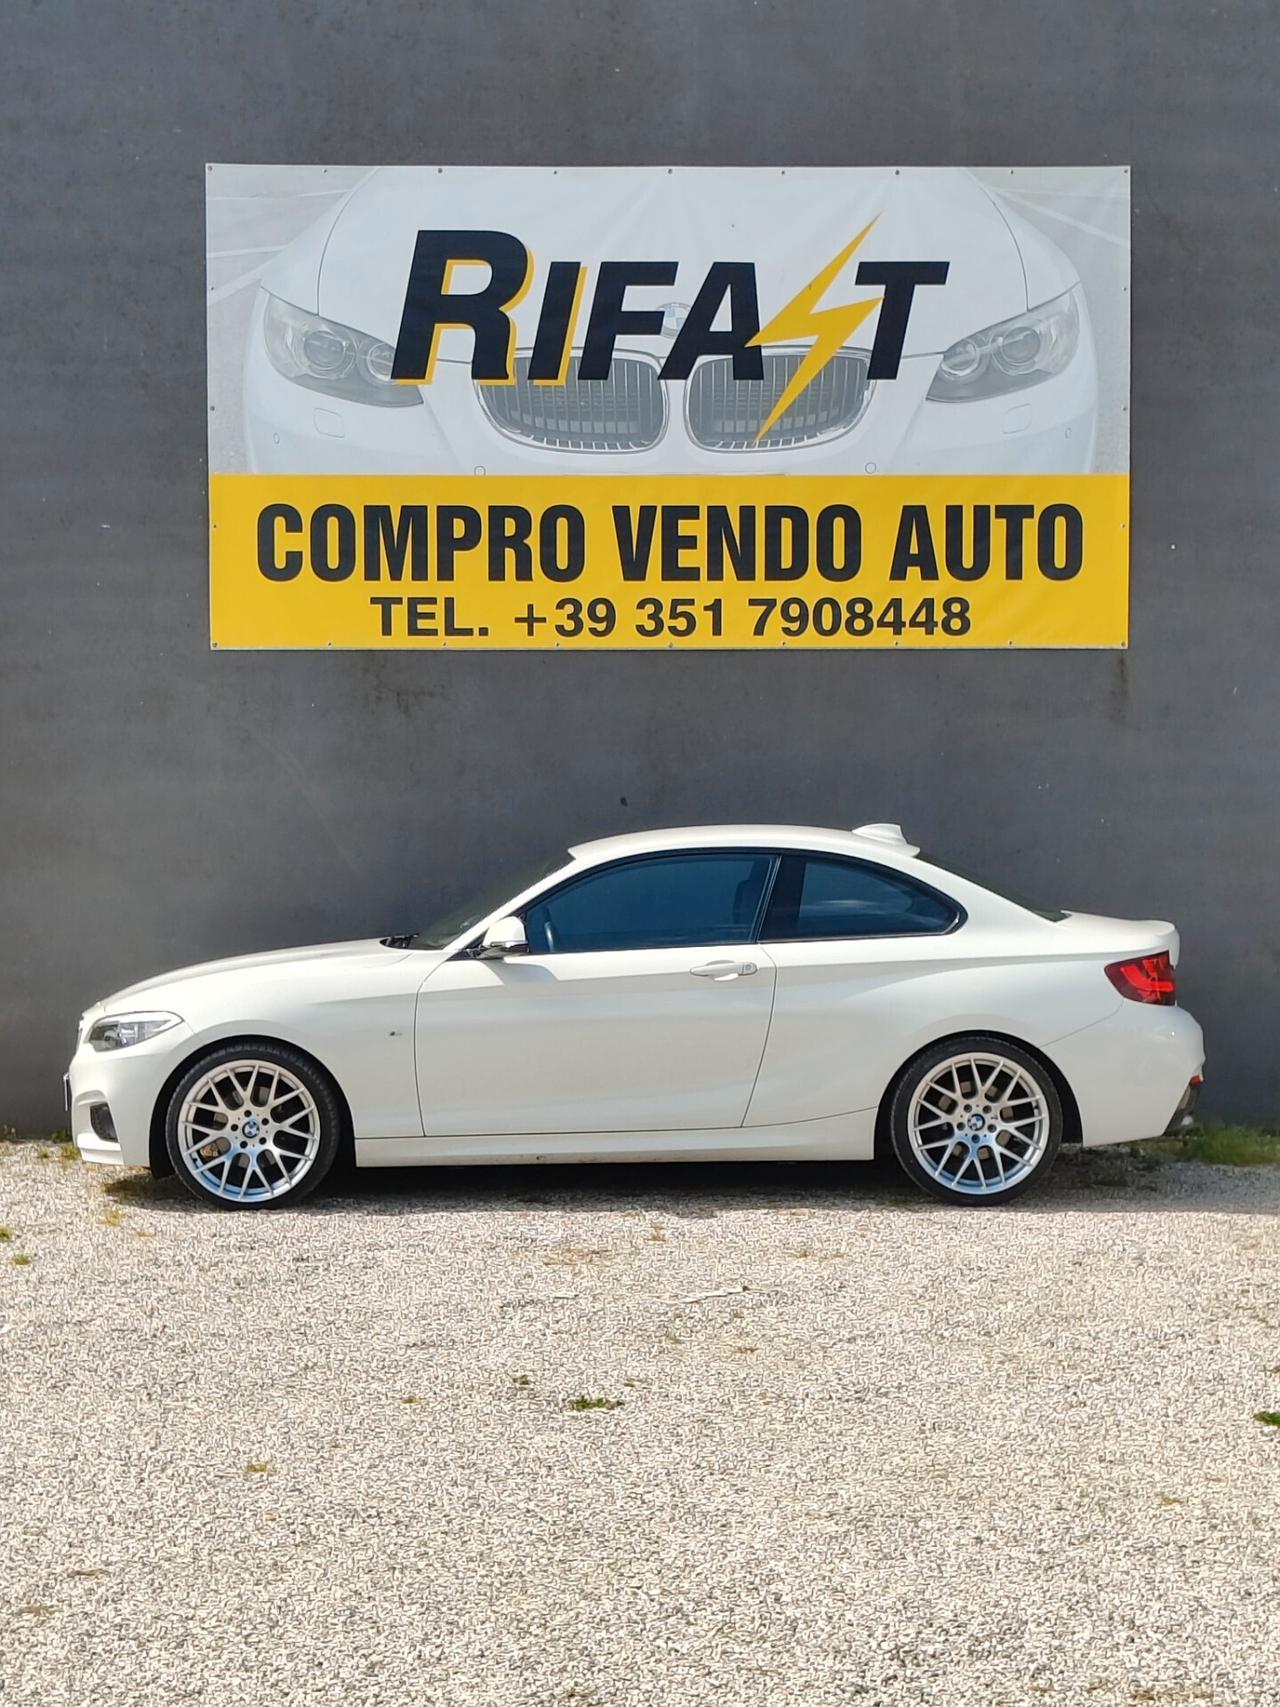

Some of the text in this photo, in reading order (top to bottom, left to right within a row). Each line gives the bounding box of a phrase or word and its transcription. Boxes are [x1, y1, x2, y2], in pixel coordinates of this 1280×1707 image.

[257, 503, 1083, 582] COMPRO VENDO AUTO
[370, 596, 972, 640] TEL. +39 351 7908448
